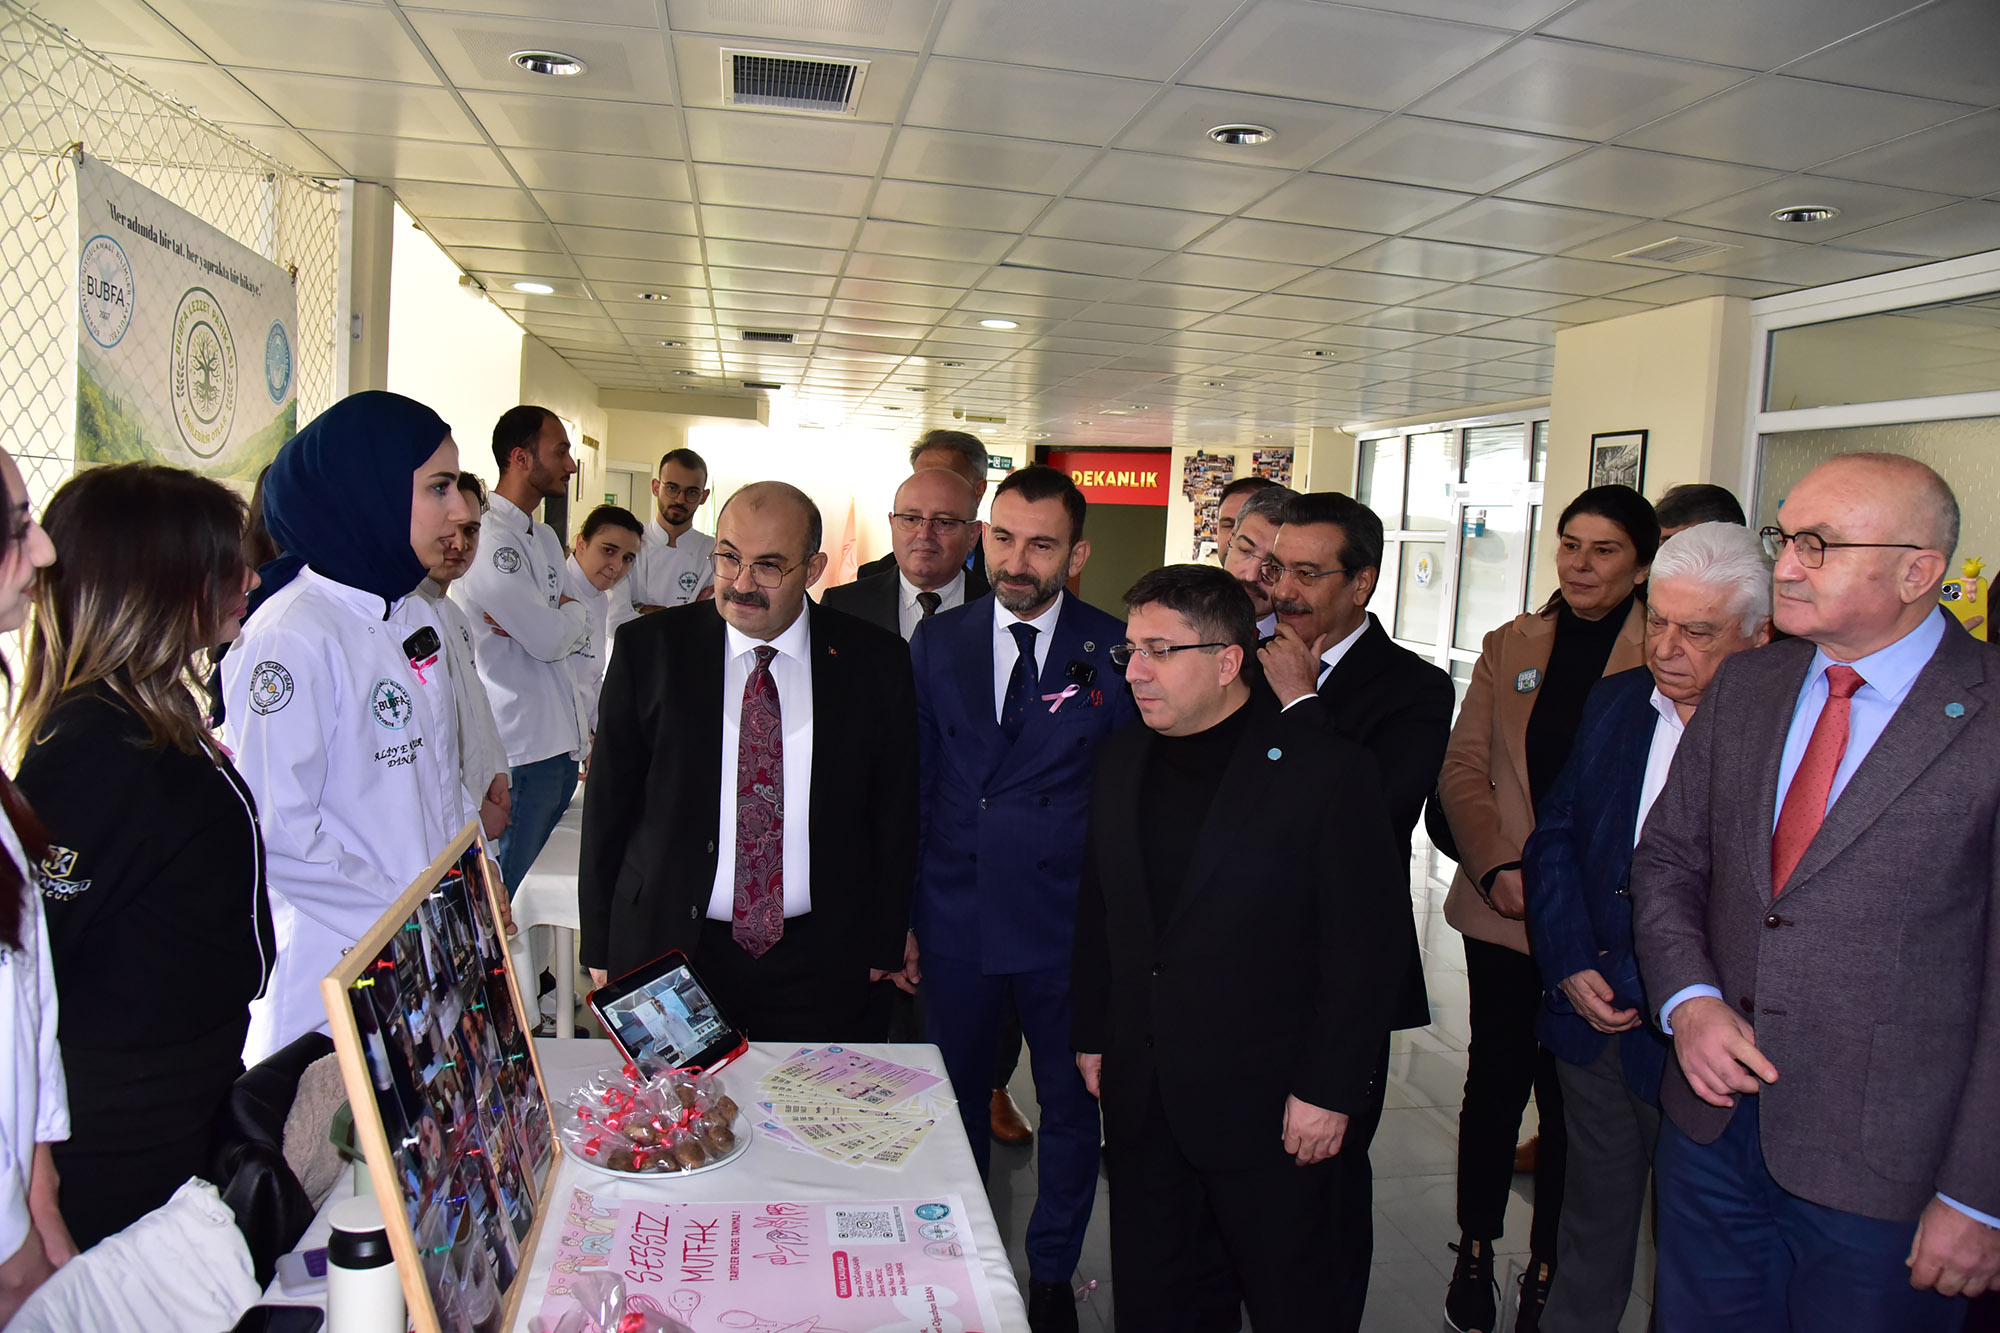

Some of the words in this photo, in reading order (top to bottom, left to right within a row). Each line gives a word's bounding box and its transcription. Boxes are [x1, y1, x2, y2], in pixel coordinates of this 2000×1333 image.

[159, 228, 171, 250] bir
[87, 274, 125, 307] BUBFA
[188, 299, 210, 315] LEZZET
[1072, 470, 1158, 488] DEKANLIK
[378, 695, 407, 712] BUBFA
[731, 1214, 741, 1236] TANIMAZ
[680, 1218, 720, 1282] MUTFAK
[730, 1238, 740, 1255] ENGEL
[729, 1257, 740, 1281] TARİFLER
[925, 1286, 935, 1303] İLBAN
[929, 1303, 942, 1327] Oğuzhan
